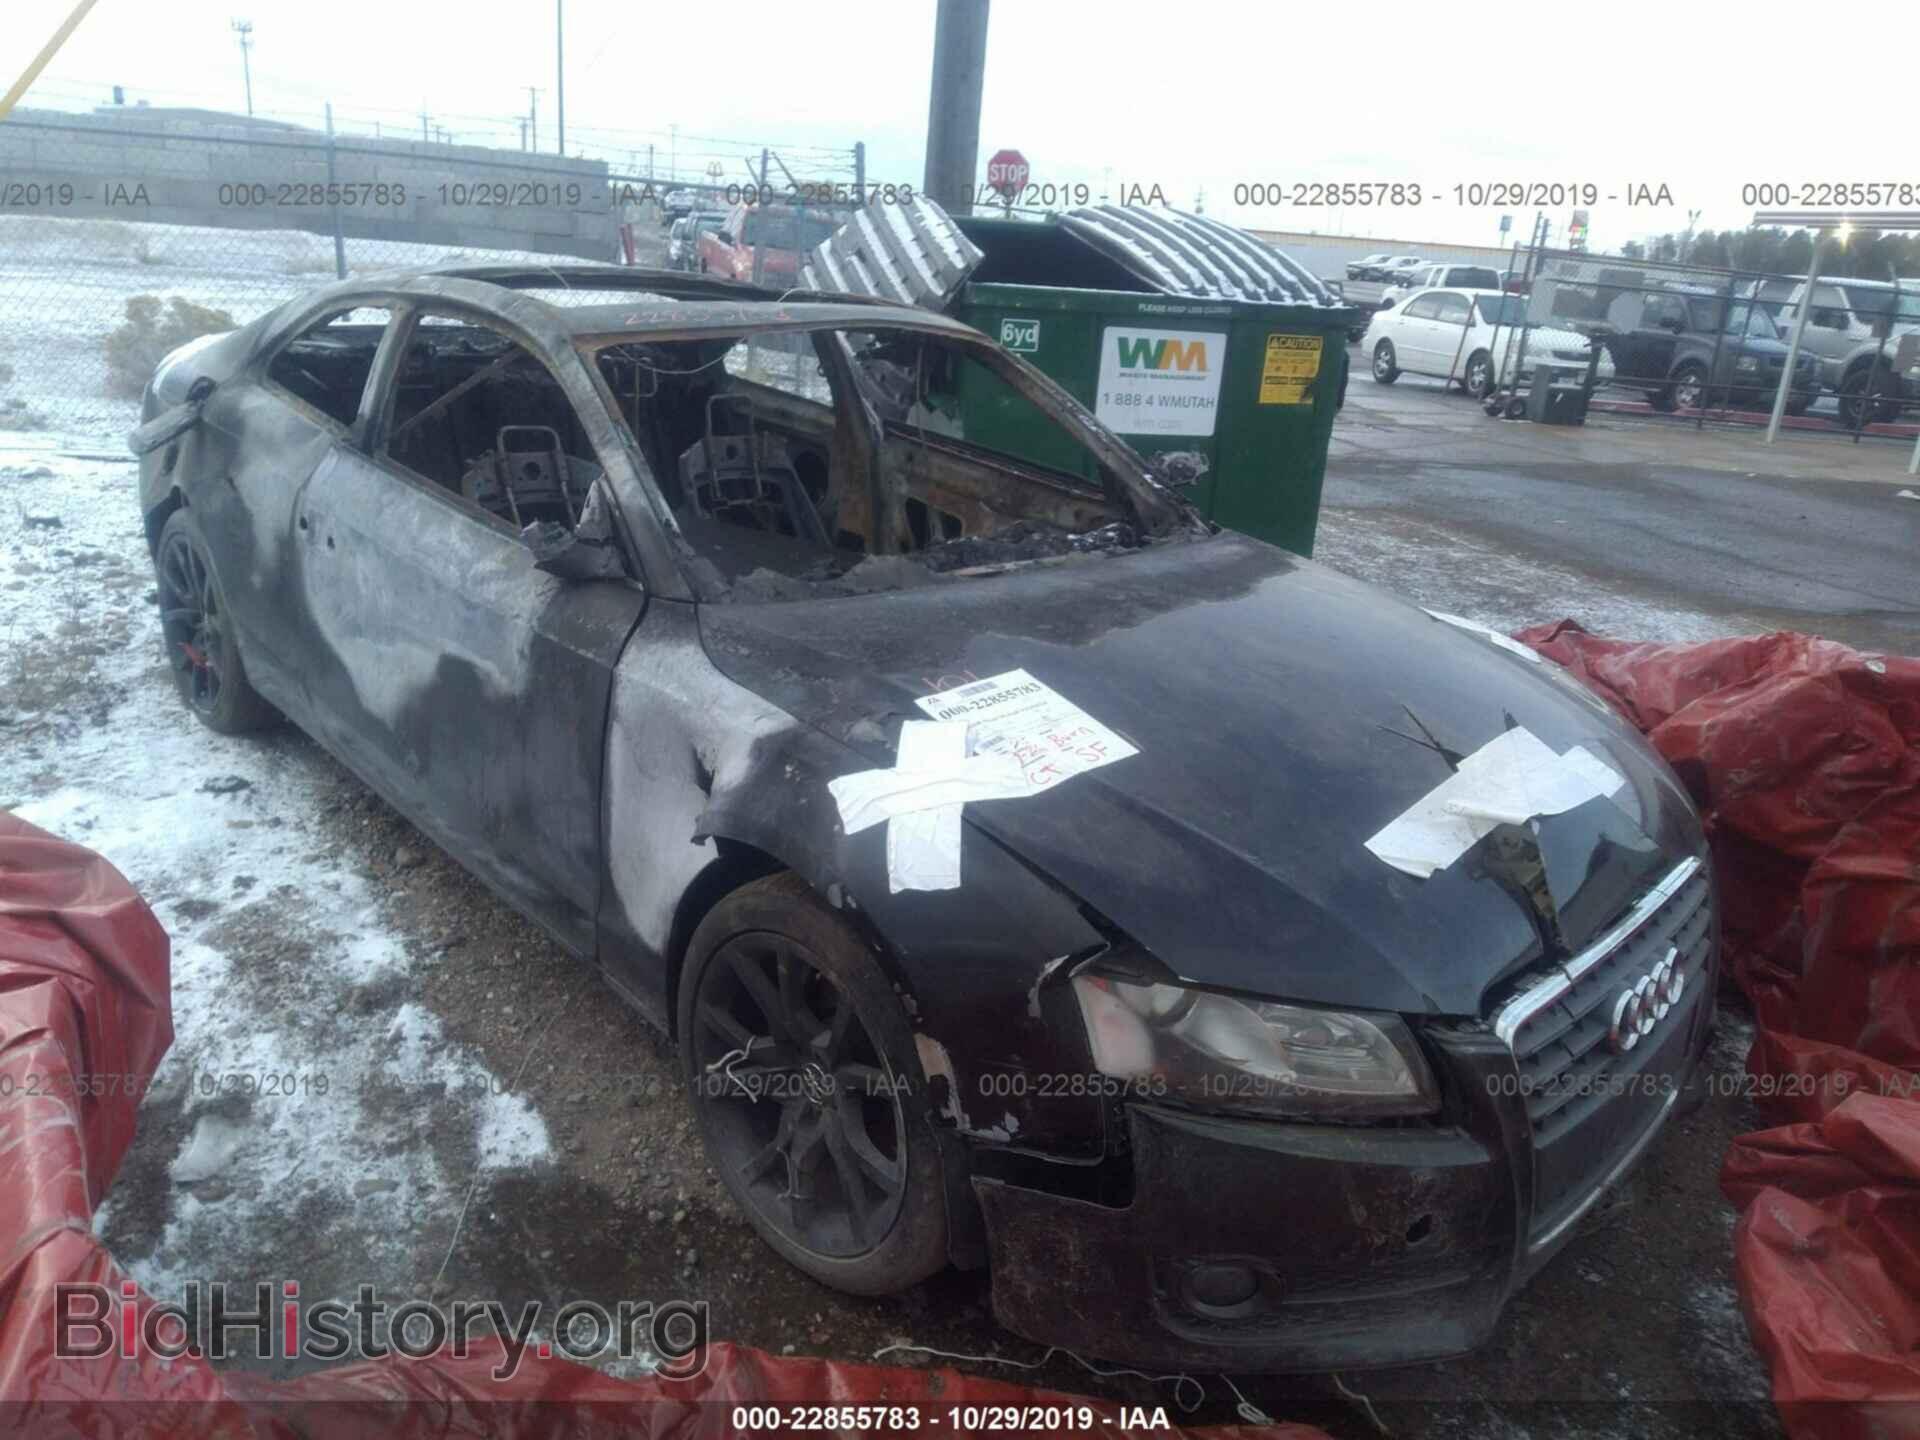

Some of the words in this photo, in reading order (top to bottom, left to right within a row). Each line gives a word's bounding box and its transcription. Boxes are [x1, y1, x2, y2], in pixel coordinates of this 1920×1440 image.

[990, 164, 1028, 182] STOP
[1003, 323, 1038, 347] 6yd
[1117, 336, 1208, 372] WM
[1115, 393, 1141, 406] 888
[1145, 394, 1154, 407] 4
[1158, 394, 1215, 409] WMUTAH
